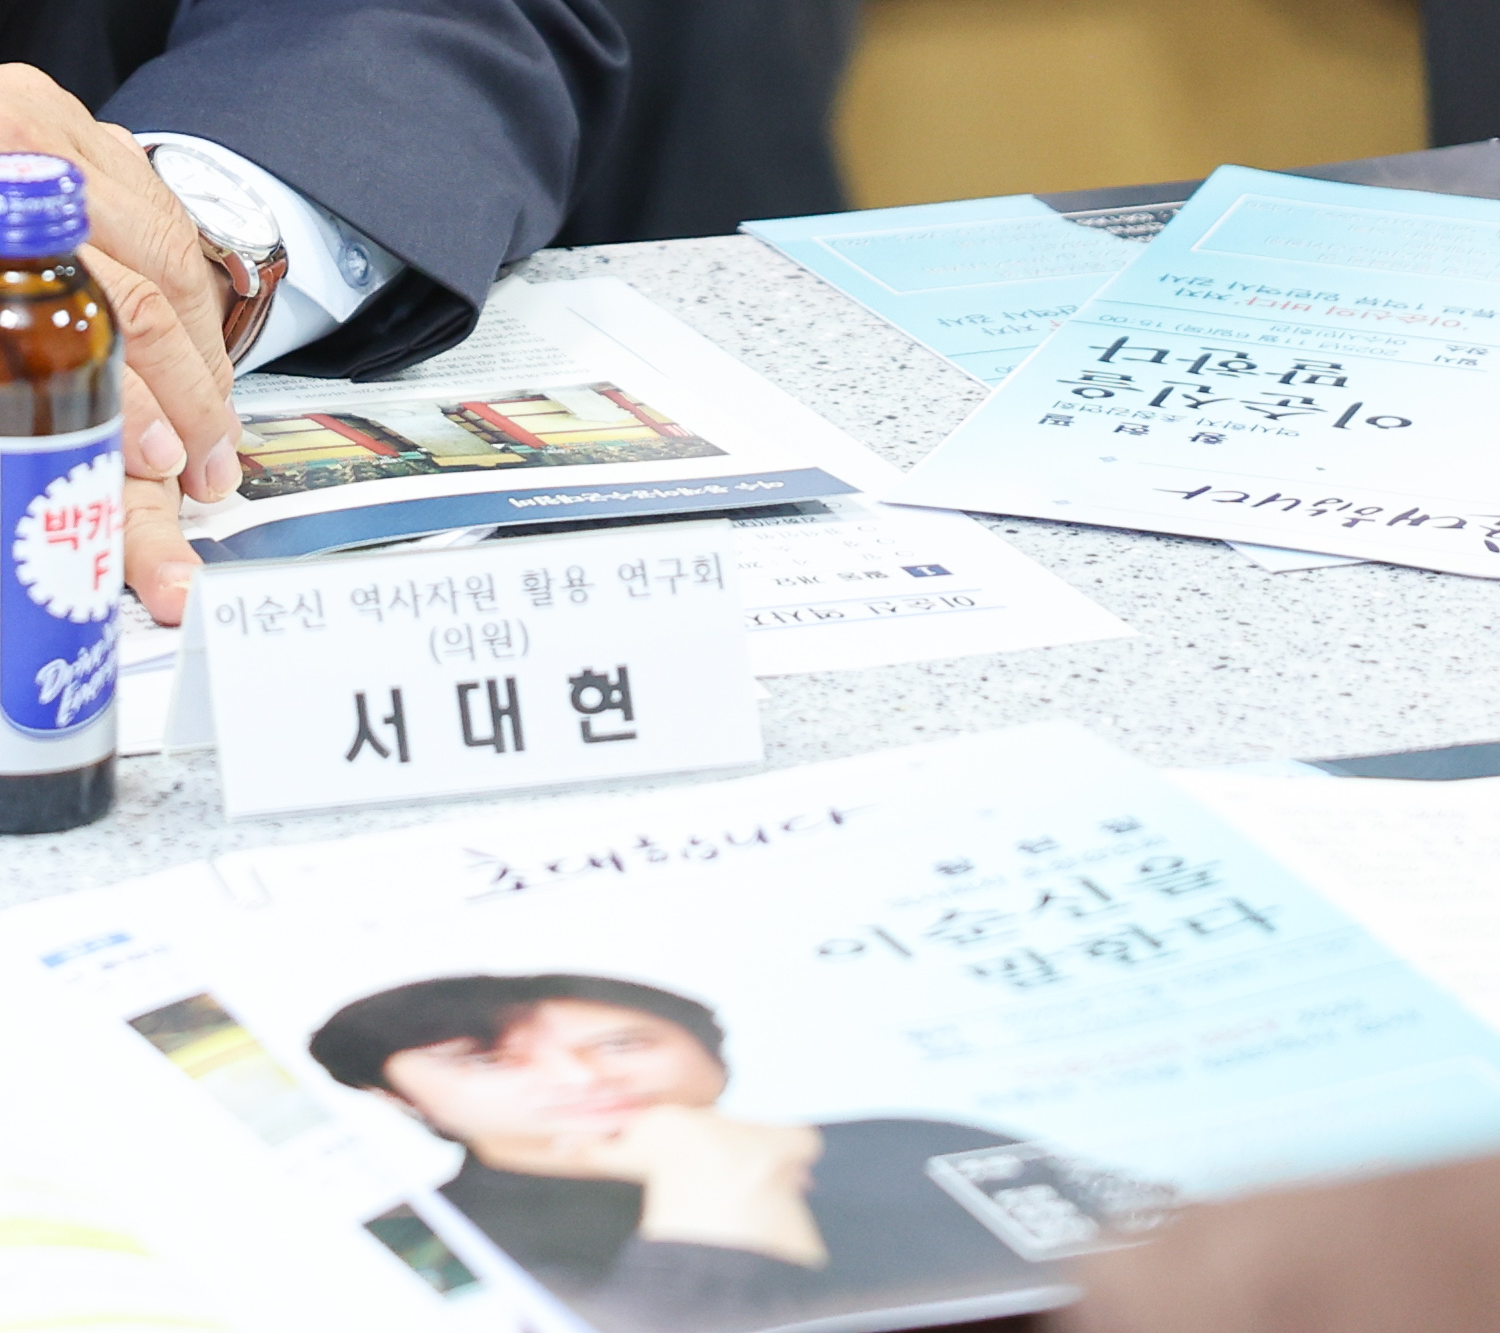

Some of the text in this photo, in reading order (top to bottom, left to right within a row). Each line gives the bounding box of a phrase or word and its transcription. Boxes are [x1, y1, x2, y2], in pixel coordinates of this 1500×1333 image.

[1173, 286, 1233, 303] 저자
[1088, 335, 1350, 390] 말한다
[1056, 369, 1414, 431] 이순신을
[43, 500, 124, 552] 박카
[93, 549, 112, 592] F
[214, 551, 727, 637] 이순신 역사자원 활용 연구회
[863, 595, 977, 617] 이순신
[427, 617, 532, 666] (의원)
[814, 852, 1234, 963] 이순신을
[965, 894, 1284, 991] 말한다
